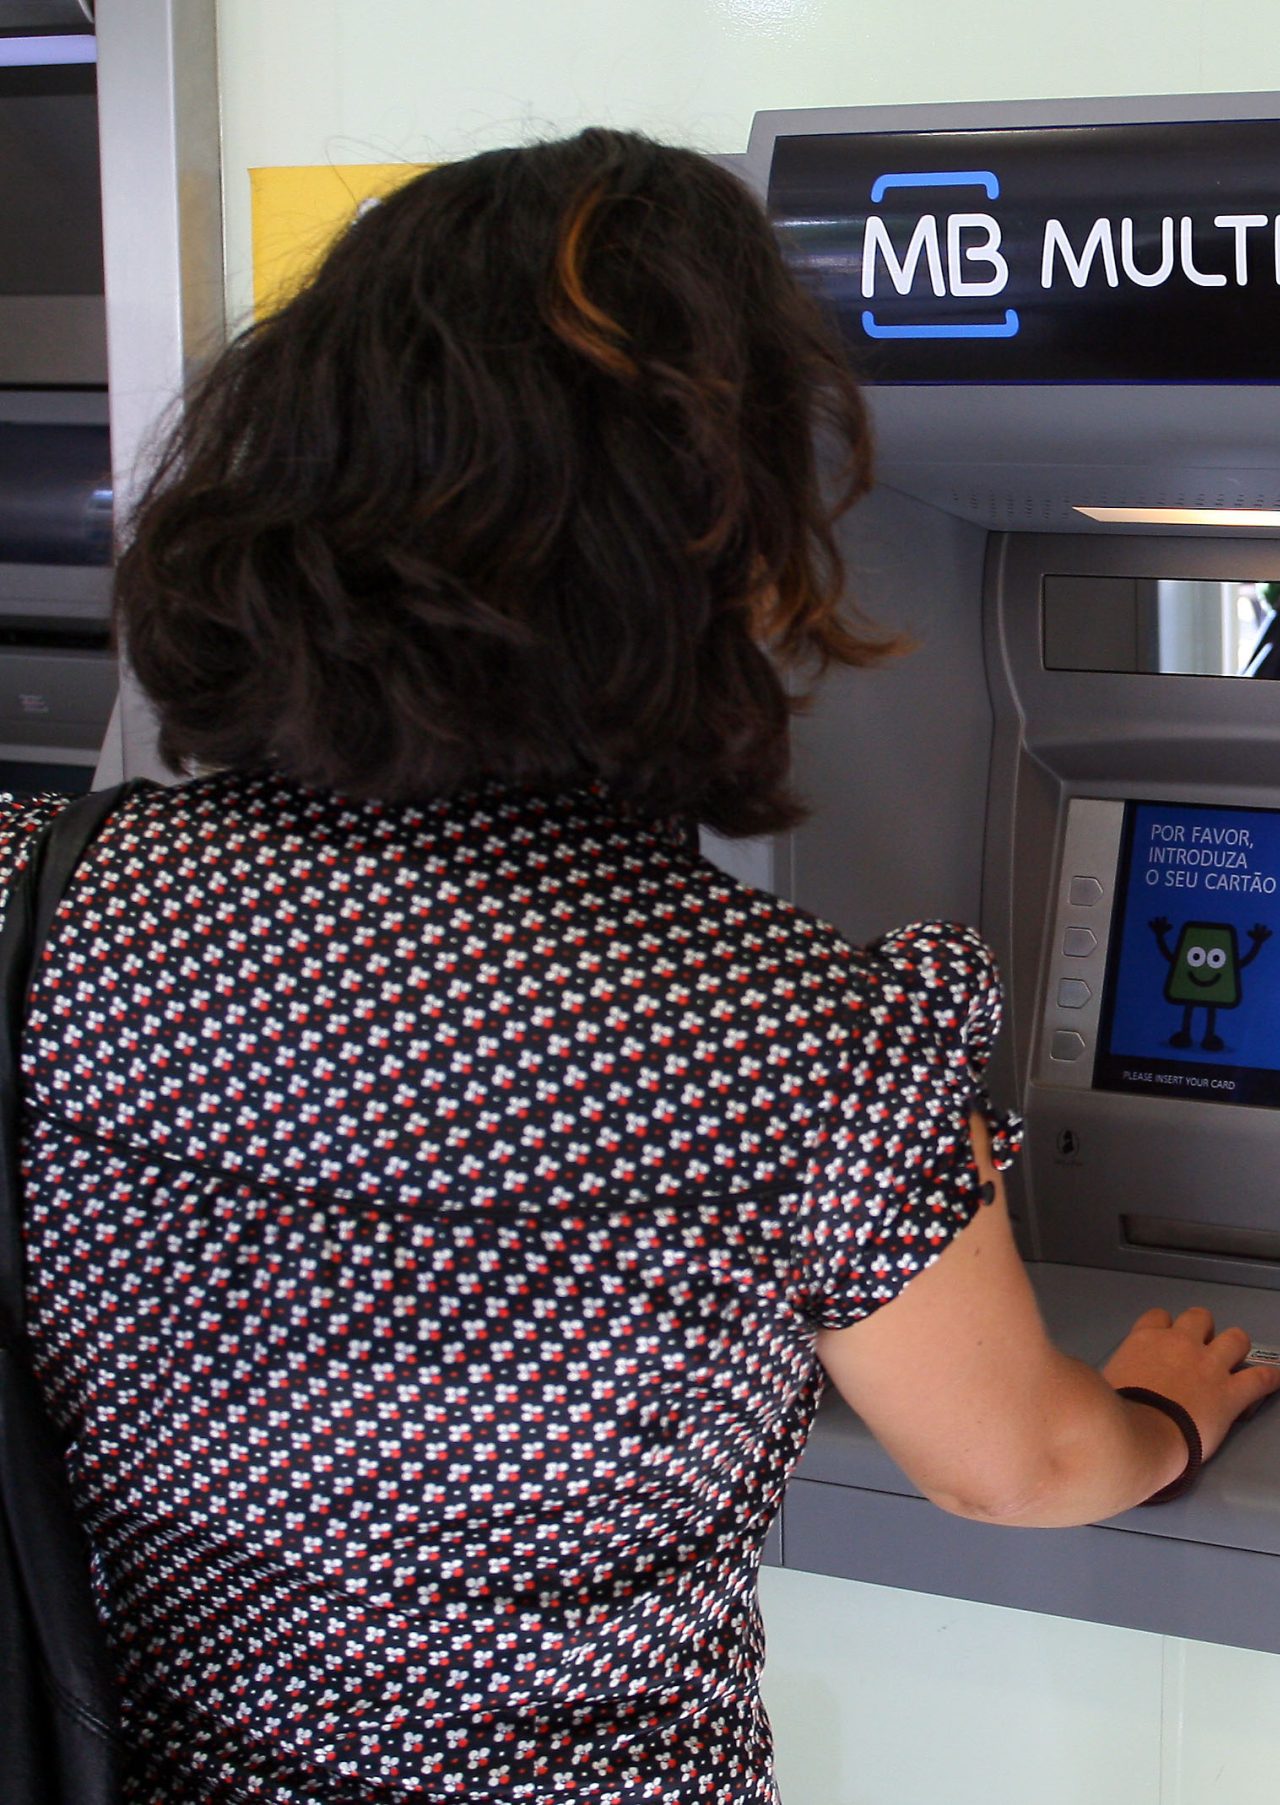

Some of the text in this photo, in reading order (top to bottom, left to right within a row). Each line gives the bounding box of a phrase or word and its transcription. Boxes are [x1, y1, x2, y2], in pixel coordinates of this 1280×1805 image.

[861, 213, 1009, 298] MB
[1151, 824, 1254, 849] POR FAVOR,
[1148, 846, 1248, 869] INTRODUZA
[1146, 869, 1277, 894] O SEU CARTÃO
[1123, 1070, 1236, 1090] PLEASE INSERT YOUR CARD
